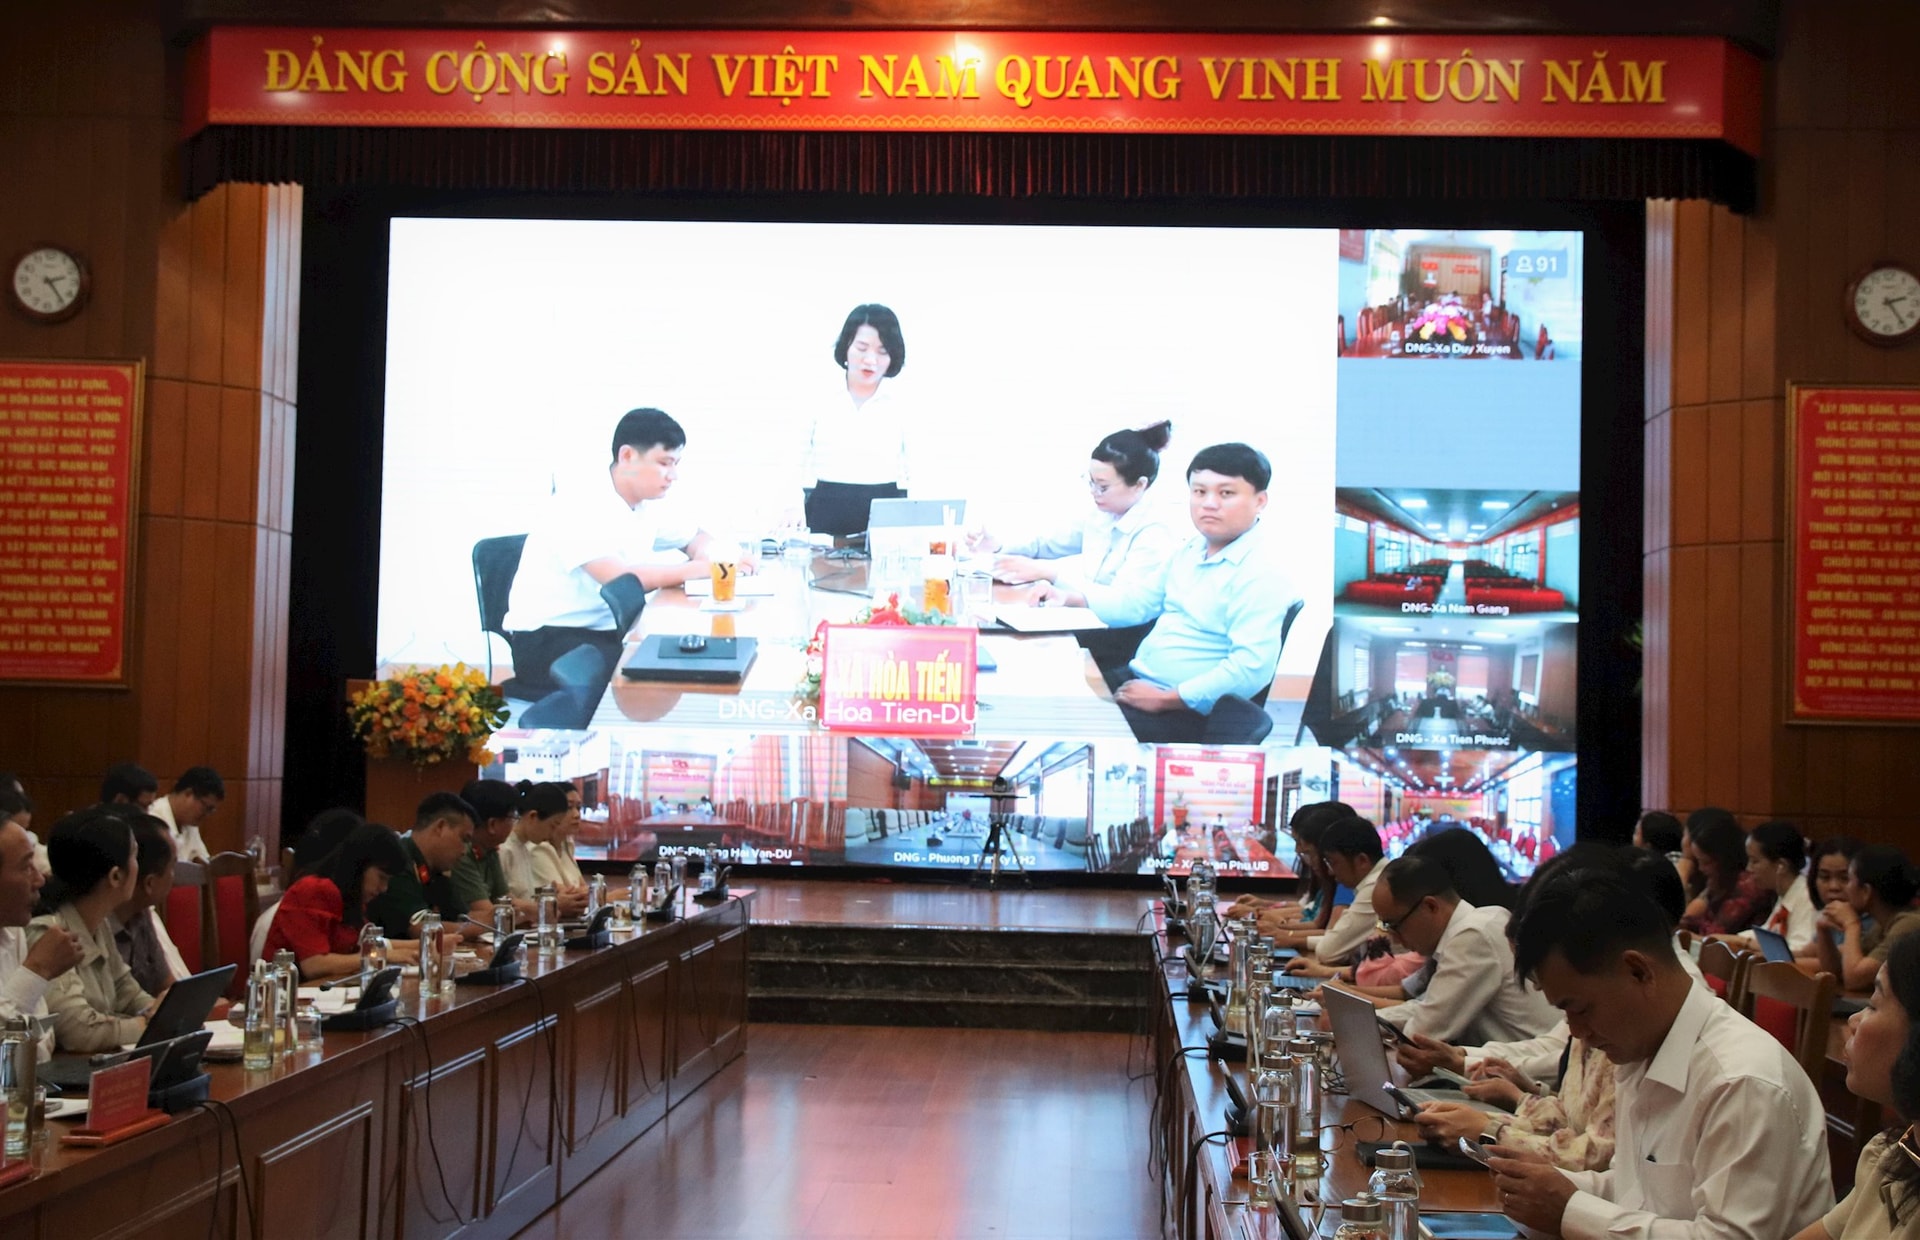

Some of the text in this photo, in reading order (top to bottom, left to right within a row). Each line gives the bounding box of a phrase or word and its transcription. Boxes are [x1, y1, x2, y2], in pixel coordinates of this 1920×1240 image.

[264, 35, 1667, 107] ĐẢNG CỘNG SẢN VIỆT NAM QUANG VINH MUÔN NĂM
[1536, 256, 1557, 272] 91
[869, 650, 910, 700] HÒA
[916, 649, 962, 702] TIẾN
[825, 703, 872, 722] Hoa
[881, 703, 979, 724] Tien-DU
[1396, 733, 1423, 743] DNG
[894, 852, 920, 862] DNG
[929, 853, 970, 865] Phuong
[1146, 858, 1172, 868] DNG
